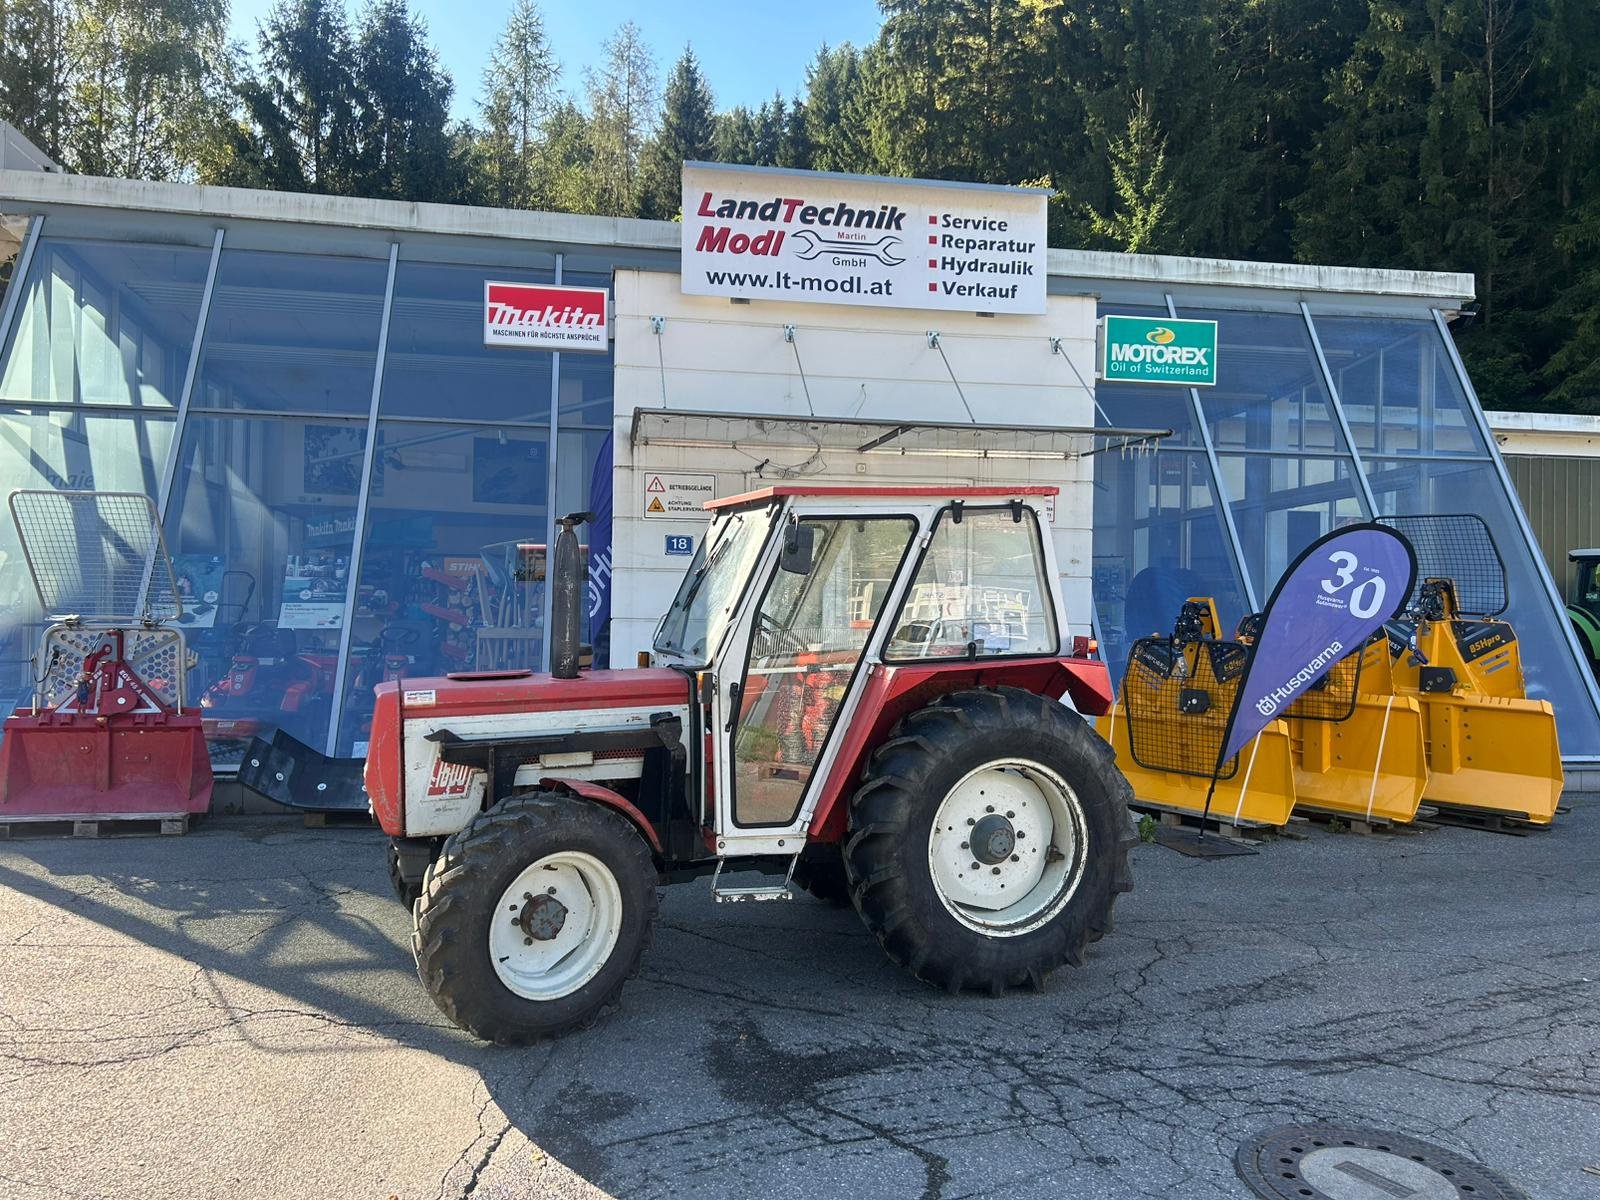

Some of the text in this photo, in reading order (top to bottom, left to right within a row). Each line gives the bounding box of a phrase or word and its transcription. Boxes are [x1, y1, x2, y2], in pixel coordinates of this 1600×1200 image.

[697, 192, 906, 231] LandTechnik
[941, 214, 1008, 232] Service
[696, 226, 786, 257] Modl
[837, 231, 866, 241] Martin
[941, 234, 1035, 254] Reparatur
[832, 256, 867, 268] GmbH
[941, 256, 1034, 276] Hydraulik
[706, 270, 893, 296] www.lt-modl.at
[942, 281, 1018, 299] Verkauf
[492, 329, 600, 342] MASCHINEN FÜR HÖCHSTE ANSPRÜCHE
[1111, 343, 1208, 365] MOTOREX
[1111, 362, 1209, 376] Oil of Switzerland
[671, 538, 687, 549] 18
[1469, 634, 1501, 653] 85Hpro
[1271, 640, 1343, 703] Husqvarna
